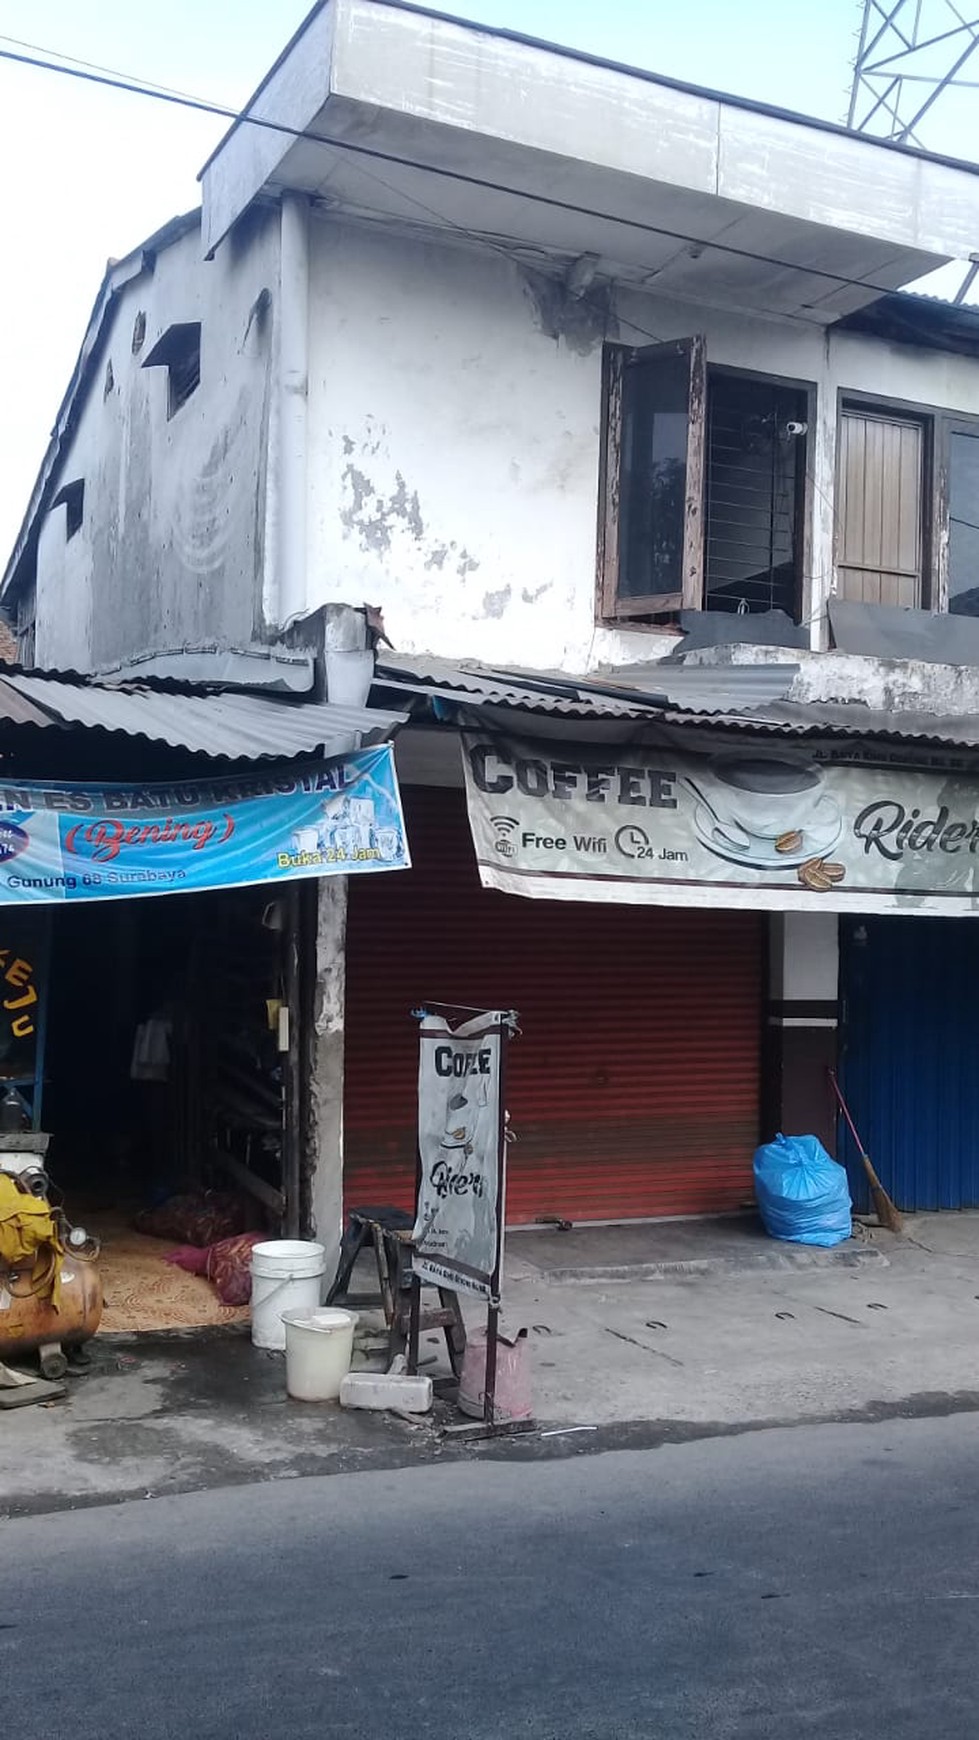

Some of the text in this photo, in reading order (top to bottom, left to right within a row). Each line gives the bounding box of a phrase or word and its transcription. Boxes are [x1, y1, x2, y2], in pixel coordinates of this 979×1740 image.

[469, 744, 678, 809] COFFEE
[42, 791, 93, 811] ES
[103, 788, 200, 813] BATU
[521, 832, 608, 853] Free Wifi
[277, 845, 382, 869] Buka 24 Jam
[637, 846, 689, 862] 24 Jam
[8, 875, 77, 889] Gunung
[107, 869, 186, 883] Surabaya
